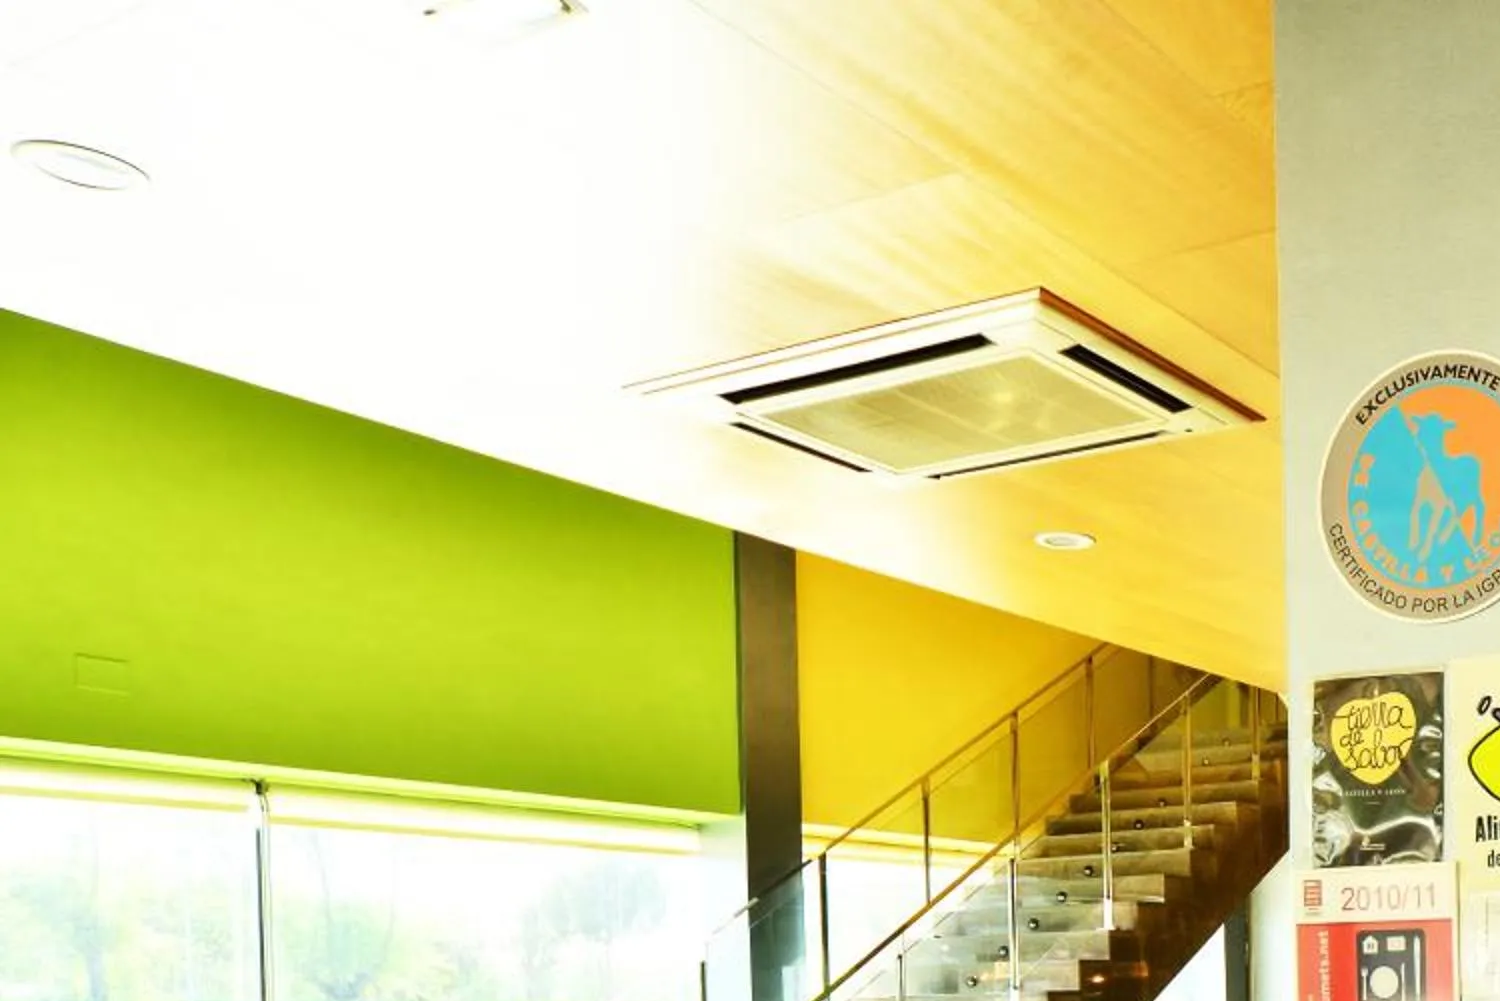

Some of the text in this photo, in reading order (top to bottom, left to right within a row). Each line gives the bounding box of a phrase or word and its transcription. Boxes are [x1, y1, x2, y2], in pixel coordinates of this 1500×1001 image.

[1329, 523, 1407, 610] CERTIFICADO
[1411, 597, 1449, 614] POR
[1453, 590, 1475, 609] LA
[1341, 882, 1436, 912] 2010/11
